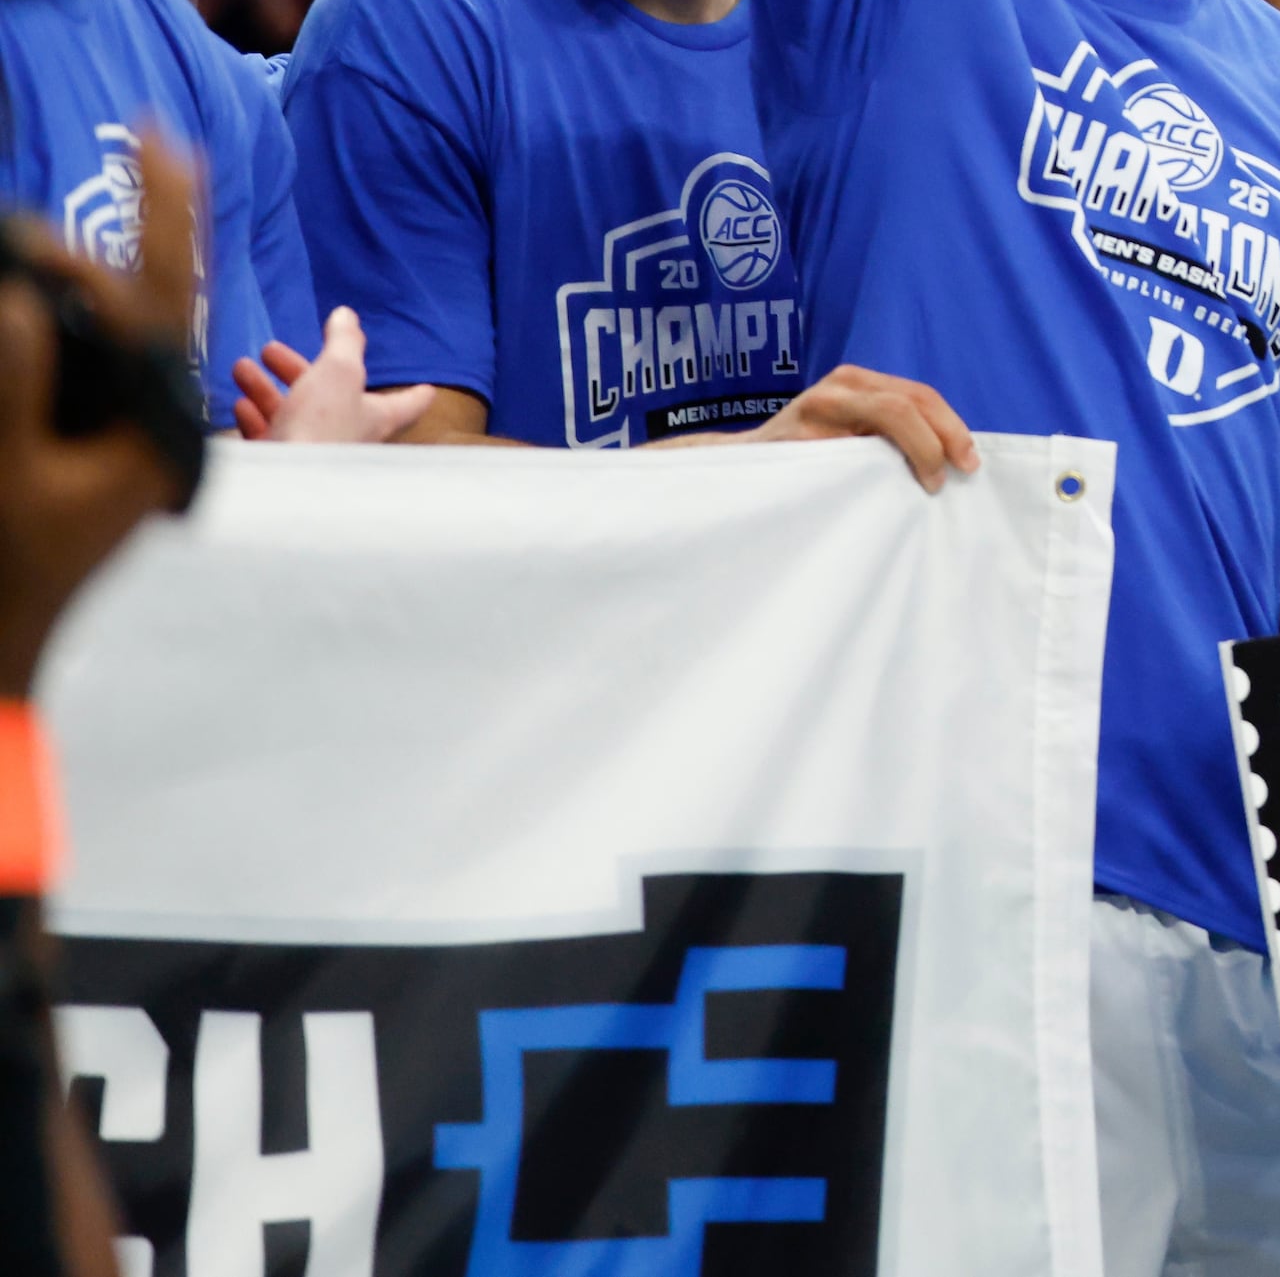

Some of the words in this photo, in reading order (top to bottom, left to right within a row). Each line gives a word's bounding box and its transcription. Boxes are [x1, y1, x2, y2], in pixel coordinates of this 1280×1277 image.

[1140, 120, 1214, 152] ACC
[1228, 179, 1271, 218] 26
[714, 214, 773, 241] ACC
[659, 259, 700, 289] 20
[667, 404, 719, 428] MEN'S
